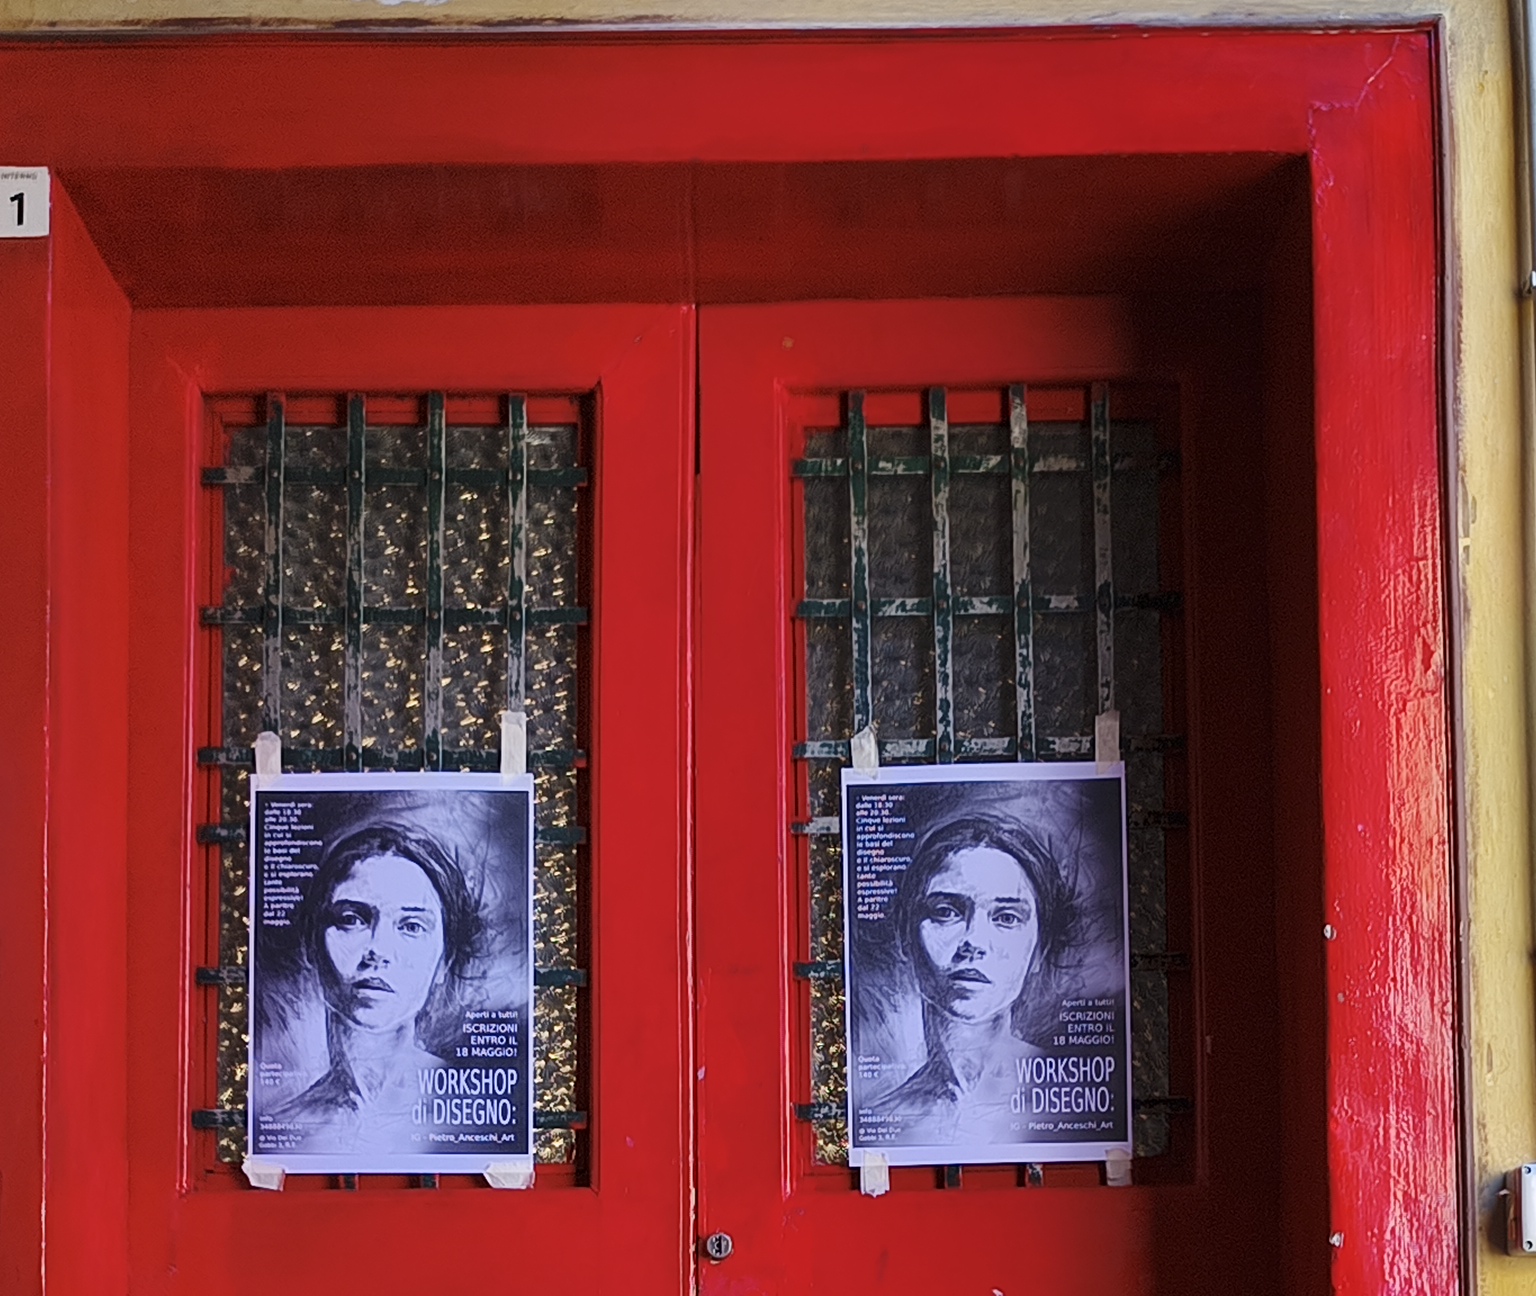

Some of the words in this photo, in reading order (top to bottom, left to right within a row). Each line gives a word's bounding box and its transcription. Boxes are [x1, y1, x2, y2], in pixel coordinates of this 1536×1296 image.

[9, 192, 25, 226] 1
[1061, 999, 1086, 1008] Aperti
[465, 1011, 489, 1020] Aperti
[1059, 1011, 1115, 1022] ISCRIZIONI
[463, 1023, 517, 1033] ISCRIZIONI
[1068, 1024, 1103, 1034] ENTRO
[1106, 1023, 1115, 1033] IL
[470, 1036, 506, 1045] ENTRO
[509, 1036, 518, 1045] IL
[1053, 1036, 1066, 1046] 18
[1069, 1035, 1115, 1045] MAGGIO!
[455, 1048, 468, 1057] 18
[471, 1048, 517, 1057] MAGGIO!
[1015, 1056, 1116, 1084] WORKSHOP
[418, 1068, 518, 1095] WORKSHOP
[1010, 1087, 1025, 1114] di
[1032, 1086, 1115, 1114] DISEGNO:
[412, 1099, 427, 1125] di
[433, 1099, 517, 1125] DISEGNO:
[1028, 1121, 1114, 1132] Pietro_Anceschi_Art
[429, 1133, 515, 1143] Pietro_Anceschi_Art
